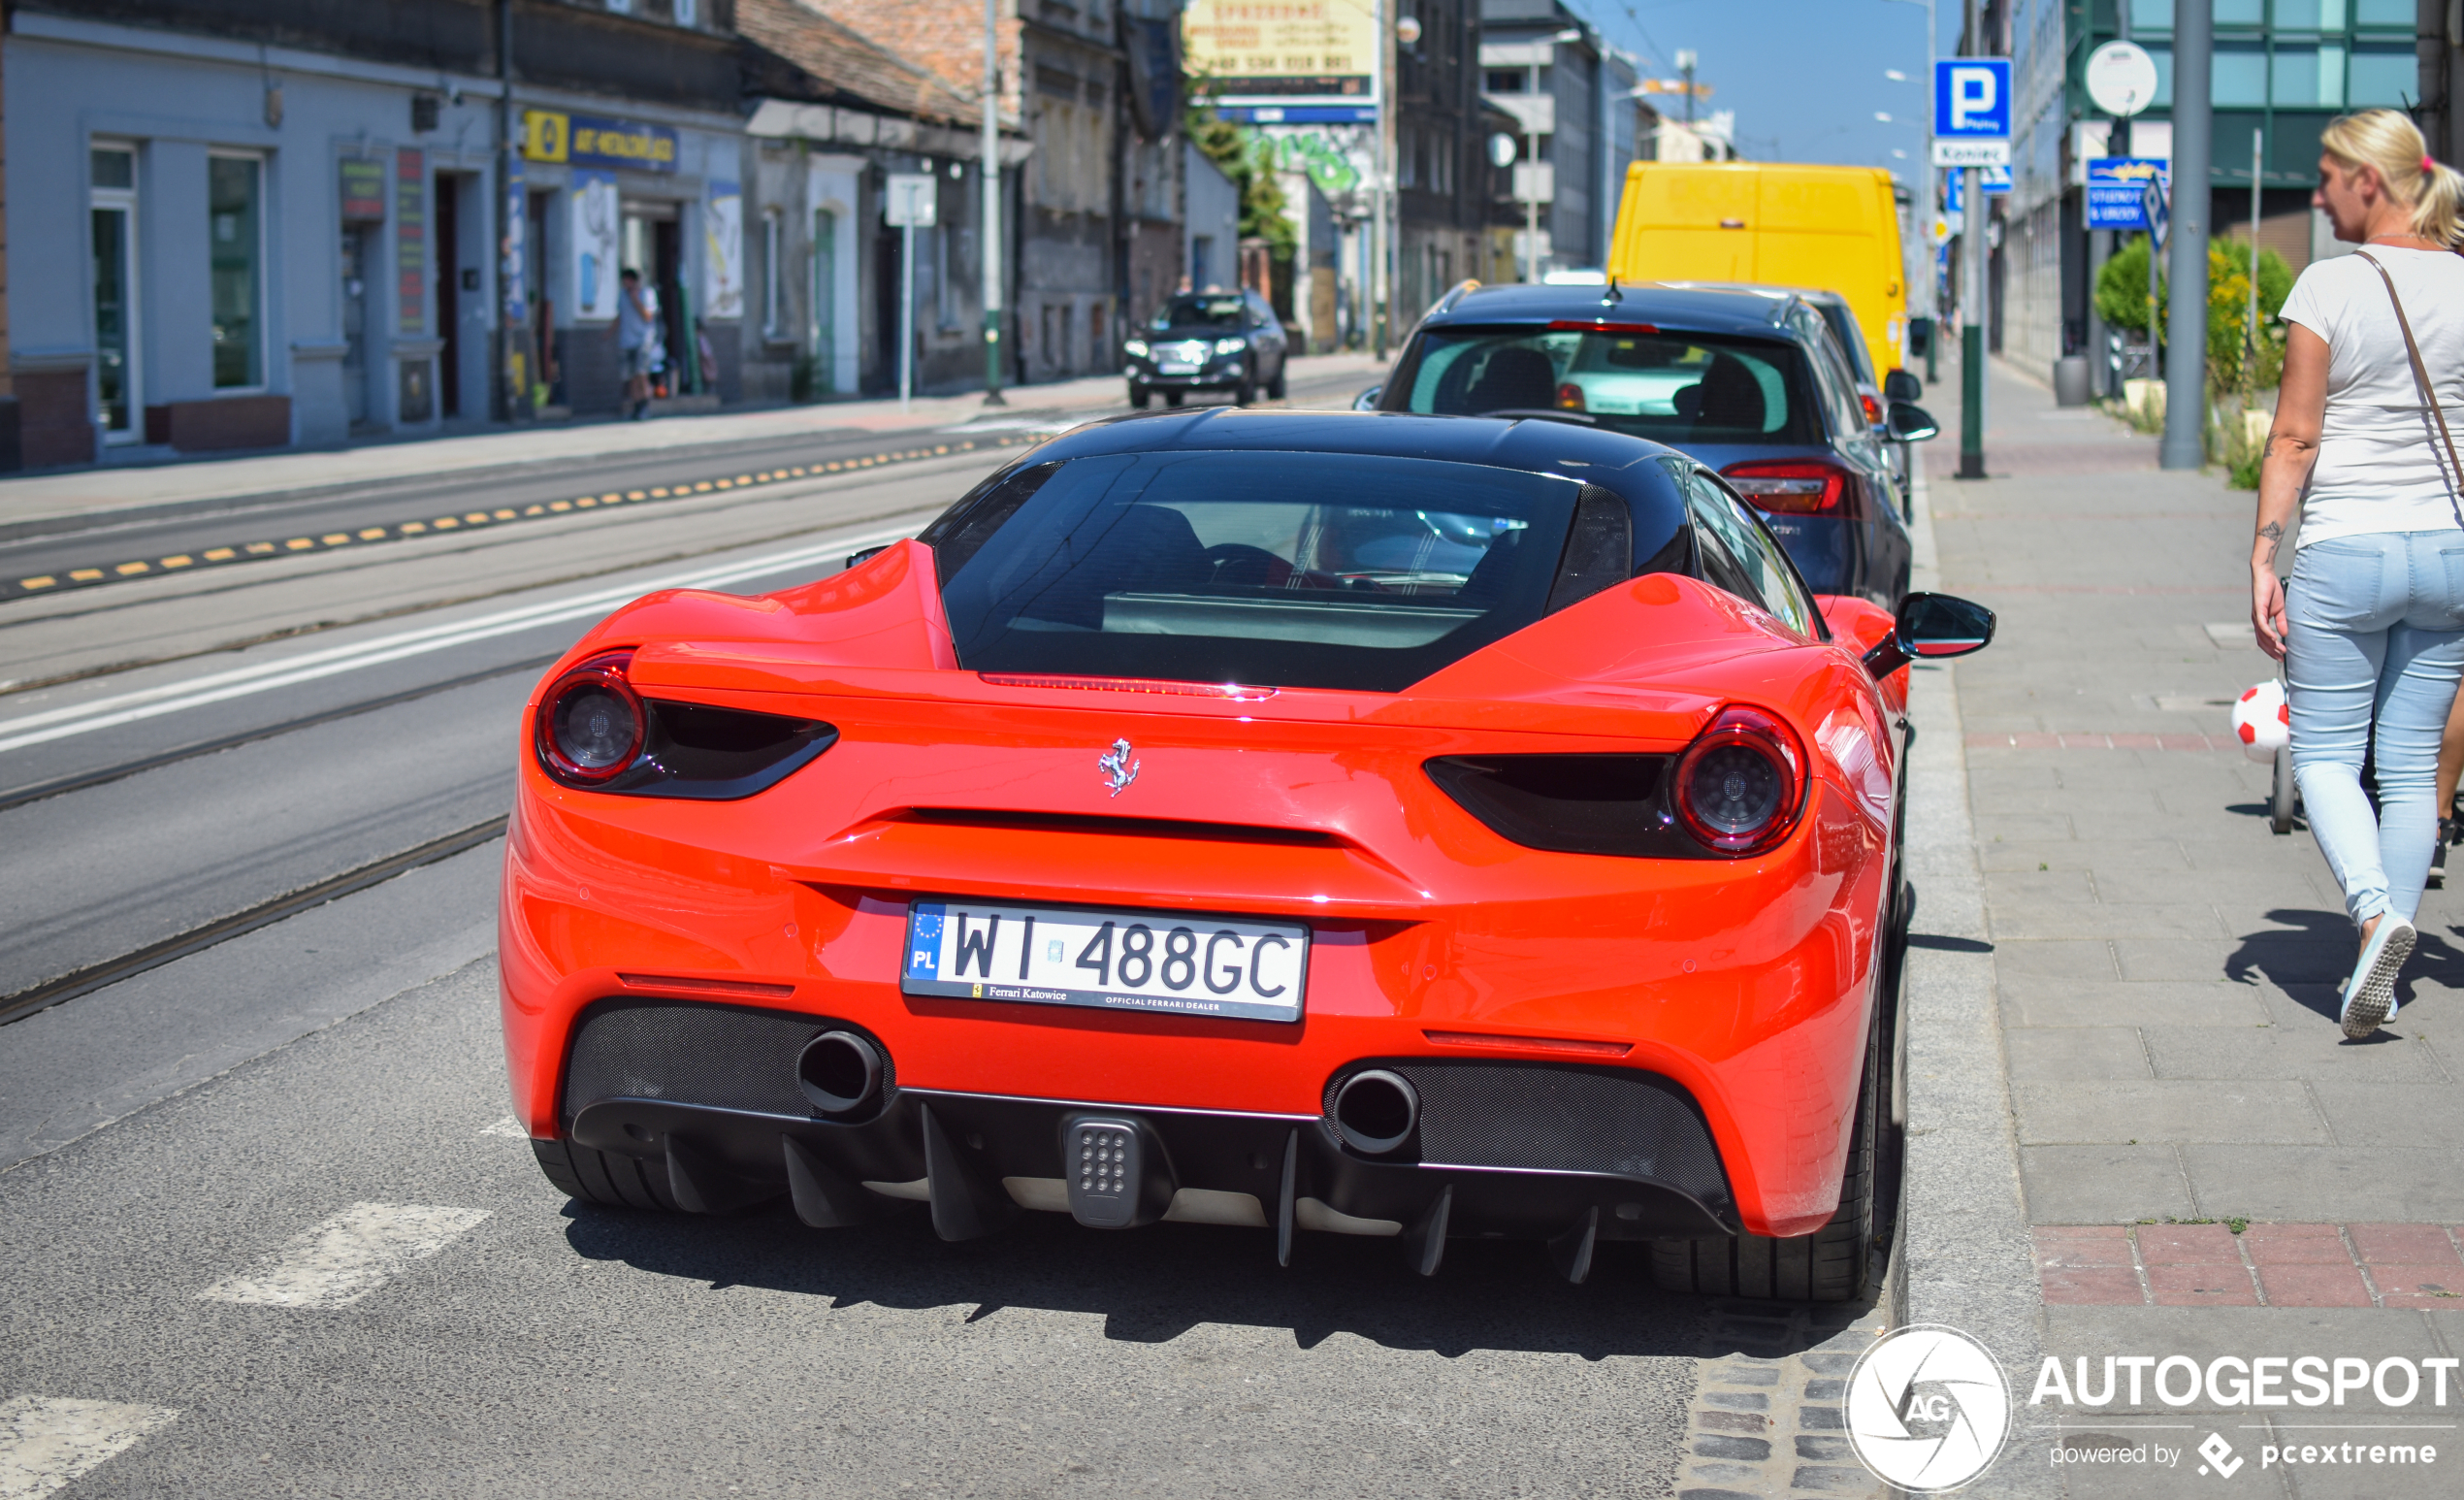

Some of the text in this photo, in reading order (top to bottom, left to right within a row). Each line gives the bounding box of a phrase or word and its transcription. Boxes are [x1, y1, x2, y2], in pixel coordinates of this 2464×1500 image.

[1952, 68, 1996, 129] P
[1942, 146, 2000, 161] Koniec
[913, 951, 935, 969] PL
[1076, 921, 1291, 998] 488GC
[989, 987, 1067, 1001] Ferrari Katowice
[1106, 996, 1220, 1011] OFFICIAL FERRARI DEALER
